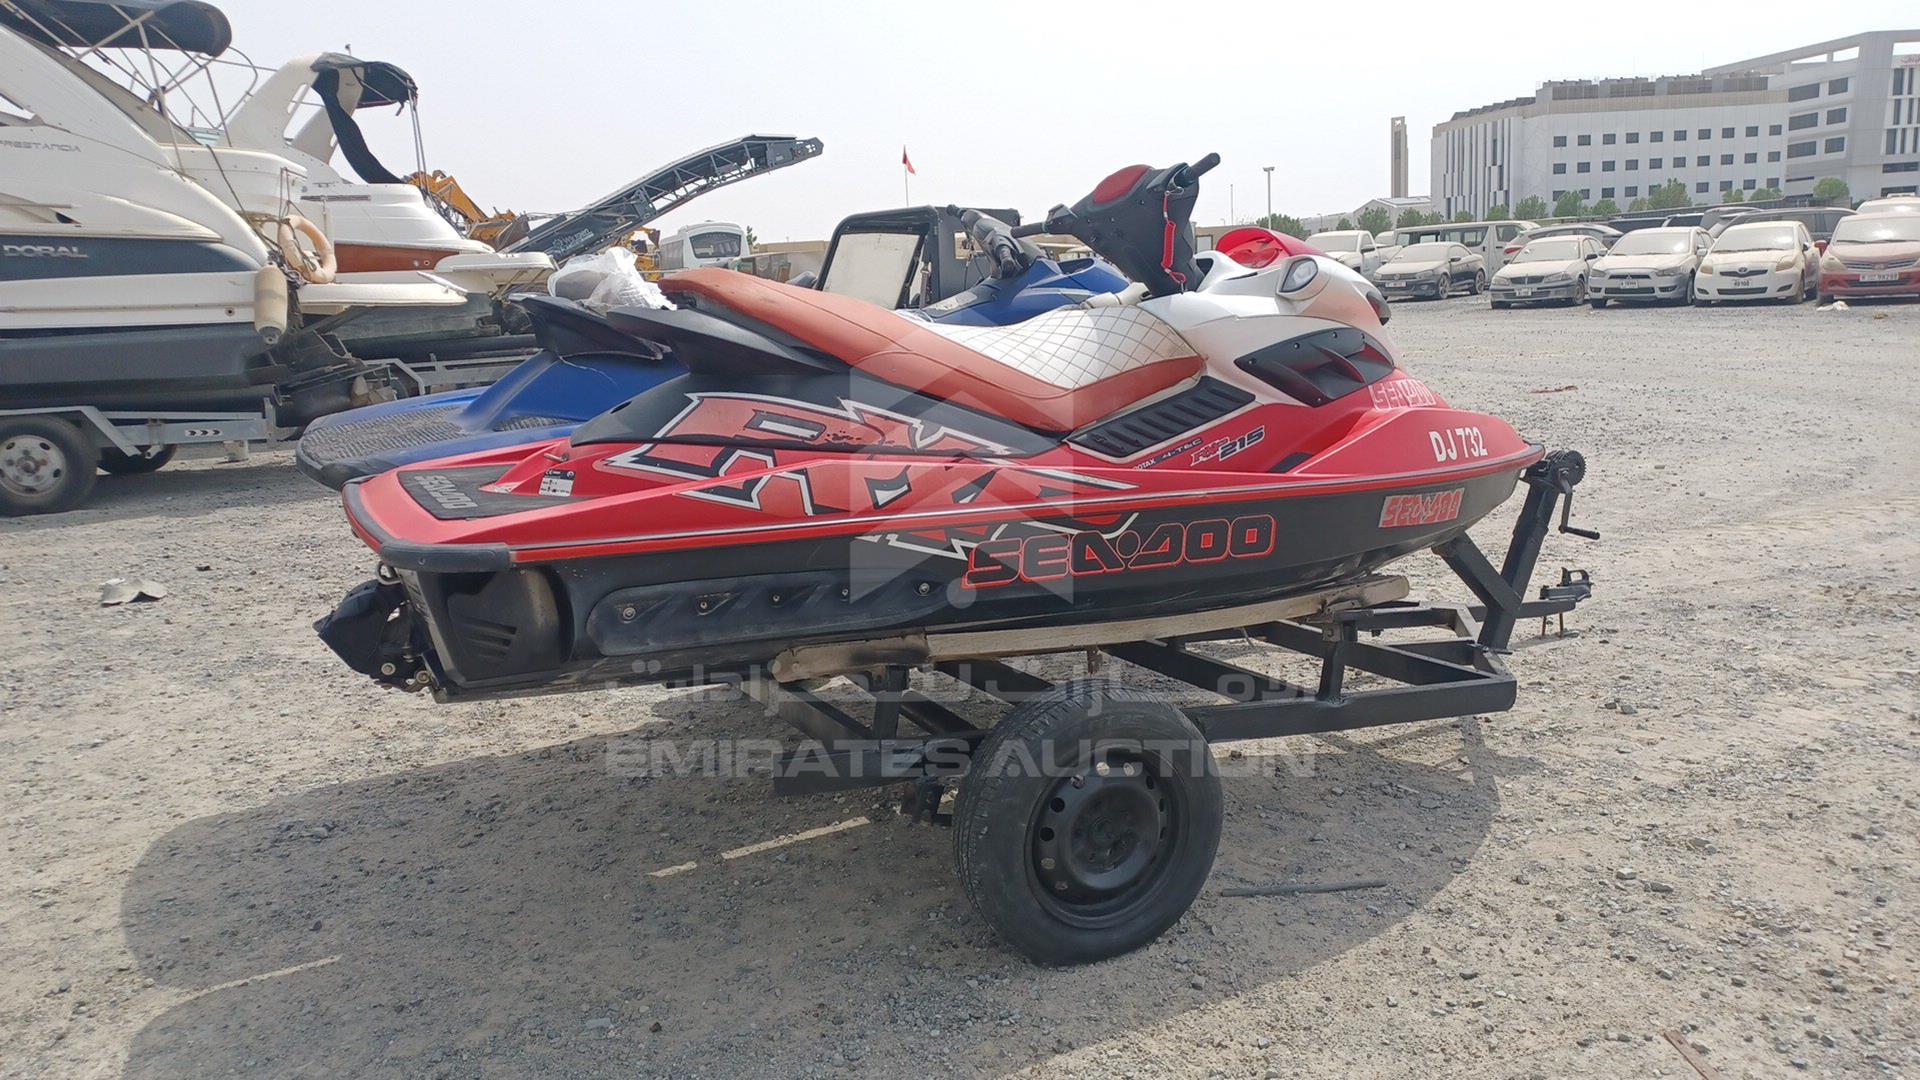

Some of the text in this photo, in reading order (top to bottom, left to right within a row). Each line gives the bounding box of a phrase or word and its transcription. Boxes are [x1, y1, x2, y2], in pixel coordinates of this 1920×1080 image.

[2, 244, 89, 258] DORAL
[1219, 425, 1265, 461] 215
[1428, 426, 1488, 462] DJ 732
